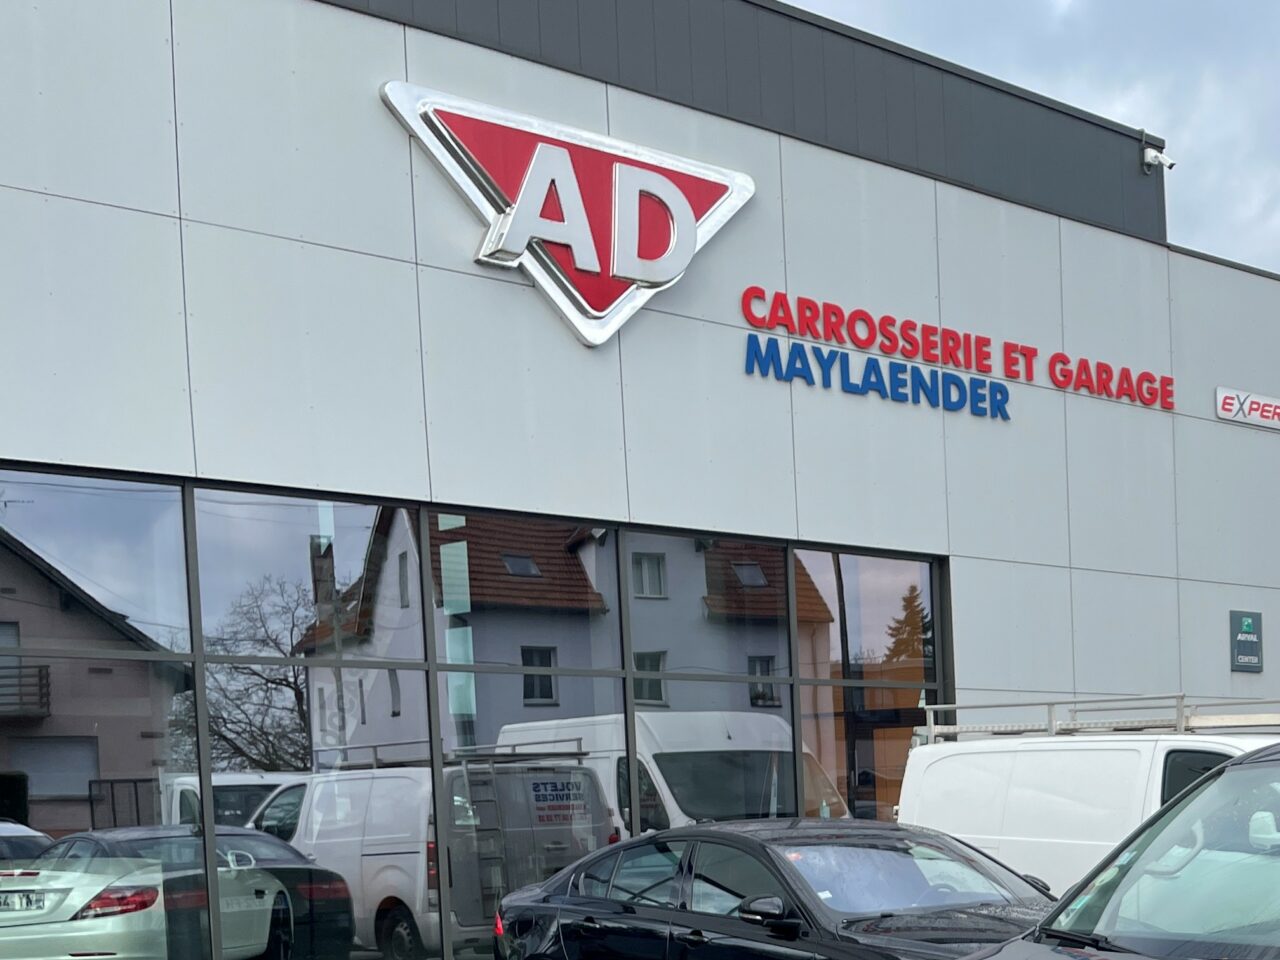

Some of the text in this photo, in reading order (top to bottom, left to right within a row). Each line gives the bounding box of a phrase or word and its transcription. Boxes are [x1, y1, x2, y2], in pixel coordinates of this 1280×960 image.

[496, 142, 698, 287] AD
[741, 285, 1175, 410] CARROSSERIE ET GARAGE
[745, 333, 1010, 420] MAYLAENDER
